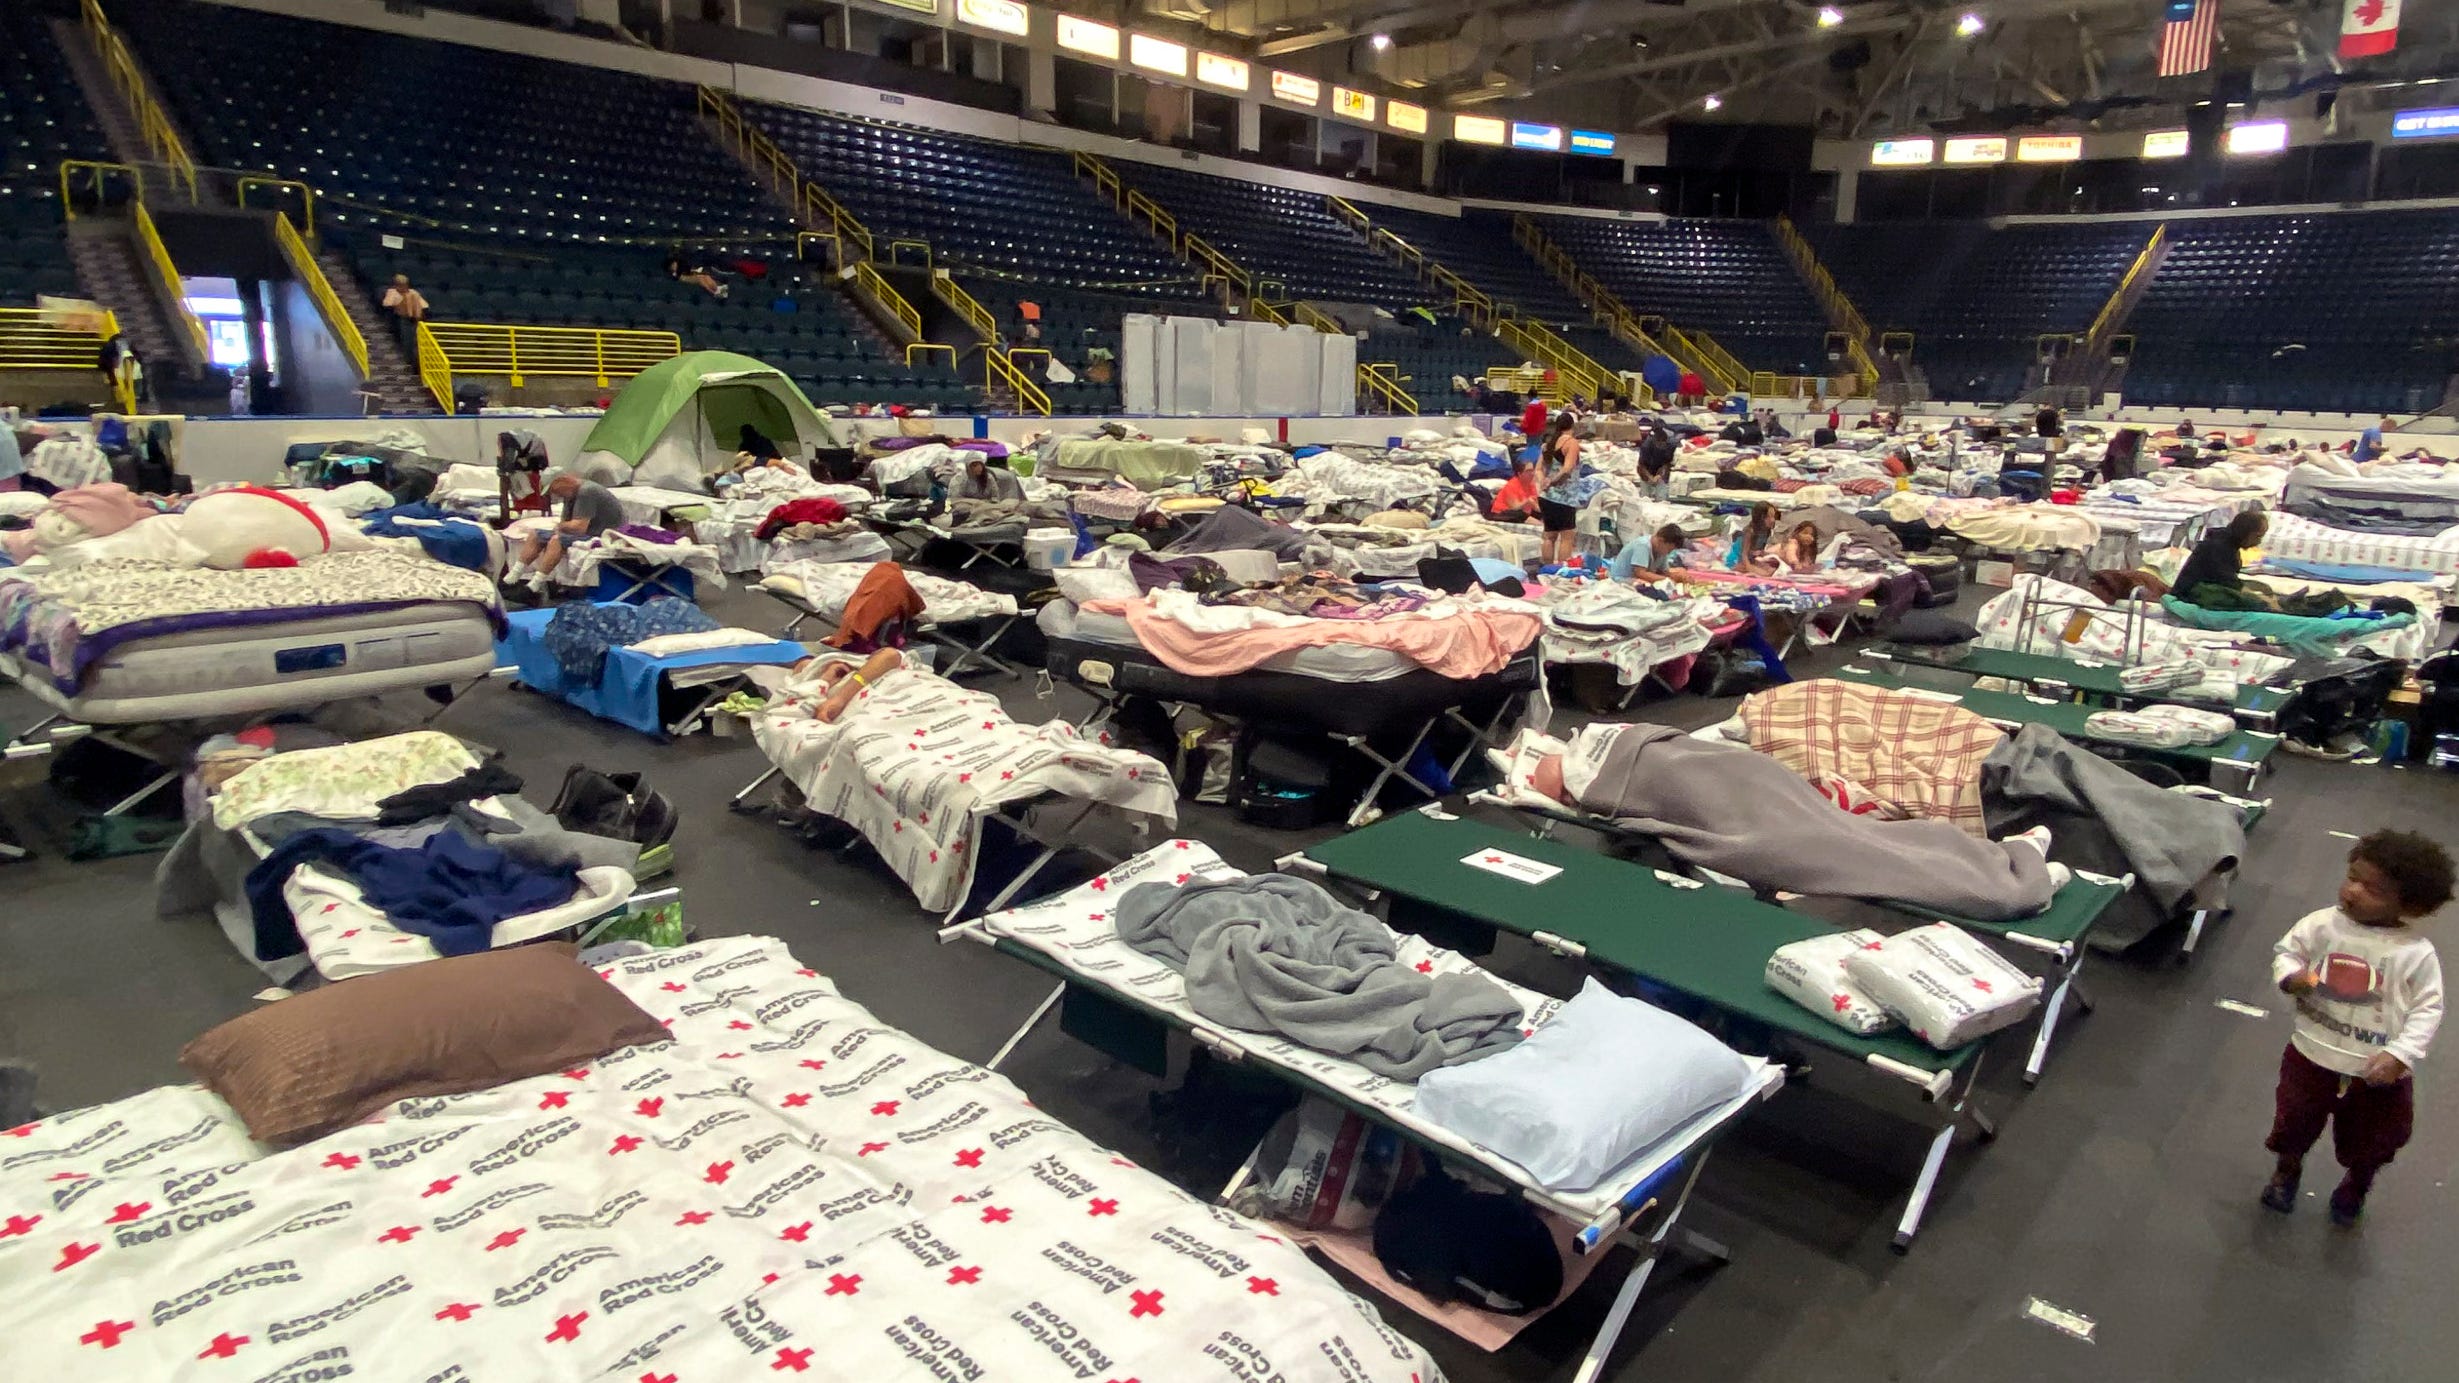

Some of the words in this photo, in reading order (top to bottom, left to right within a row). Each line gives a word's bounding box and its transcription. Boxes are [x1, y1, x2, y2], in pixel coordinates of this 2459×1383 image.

[625, 961, 656, 975] Red
[657, 950, 704, 969] Cross
[760, 1005, 791, 1025] Red
[909, 1080, 945, 1100] Red
[469, 1116, 573, 1169] American
[472, 1154, 518, 1176] Red
[520, 1121, 582, 1158] Cross
[166, 1174, 218, 1206] Red
[1065, 1173, 1099, 1194] Red
[116, 1220, 172, 1250] Red
[177, 1199, 256, 1232] Cross
[824, 1201, 867, 1221] Red
[925, 1239, 962, 1262] Red
[1056, 1240, 1104, 1269] Cross
[1150, 1231, 1238, 1279] American
[1165, 1225, 1214, 1257] Cross
[151, 1258, 297, 1316] American
[218, 1272, 303, 1297] Cross
[600, 1254, 715, 1303] American
[603, 1287, 654, 1314] Red
[656, 1263, 725, 1293] Cross
[1040, 1247, 1122, 1294] American
[1100, 1264, 1138, 1285] Red
[267, 1274, 406, 1335] American
[1027, 1300, 1077, 1340] Cross
[757, 1320, 794, 1343] Red
[903, 1315, 950, 1352] Cross
[1009, 1309, 1096, 1380] American
[944, 1346, 985, 1382] Red
[1072, 1338, 1114, 1373] Red
[1218, 1331, 1272, 1375] Cross
